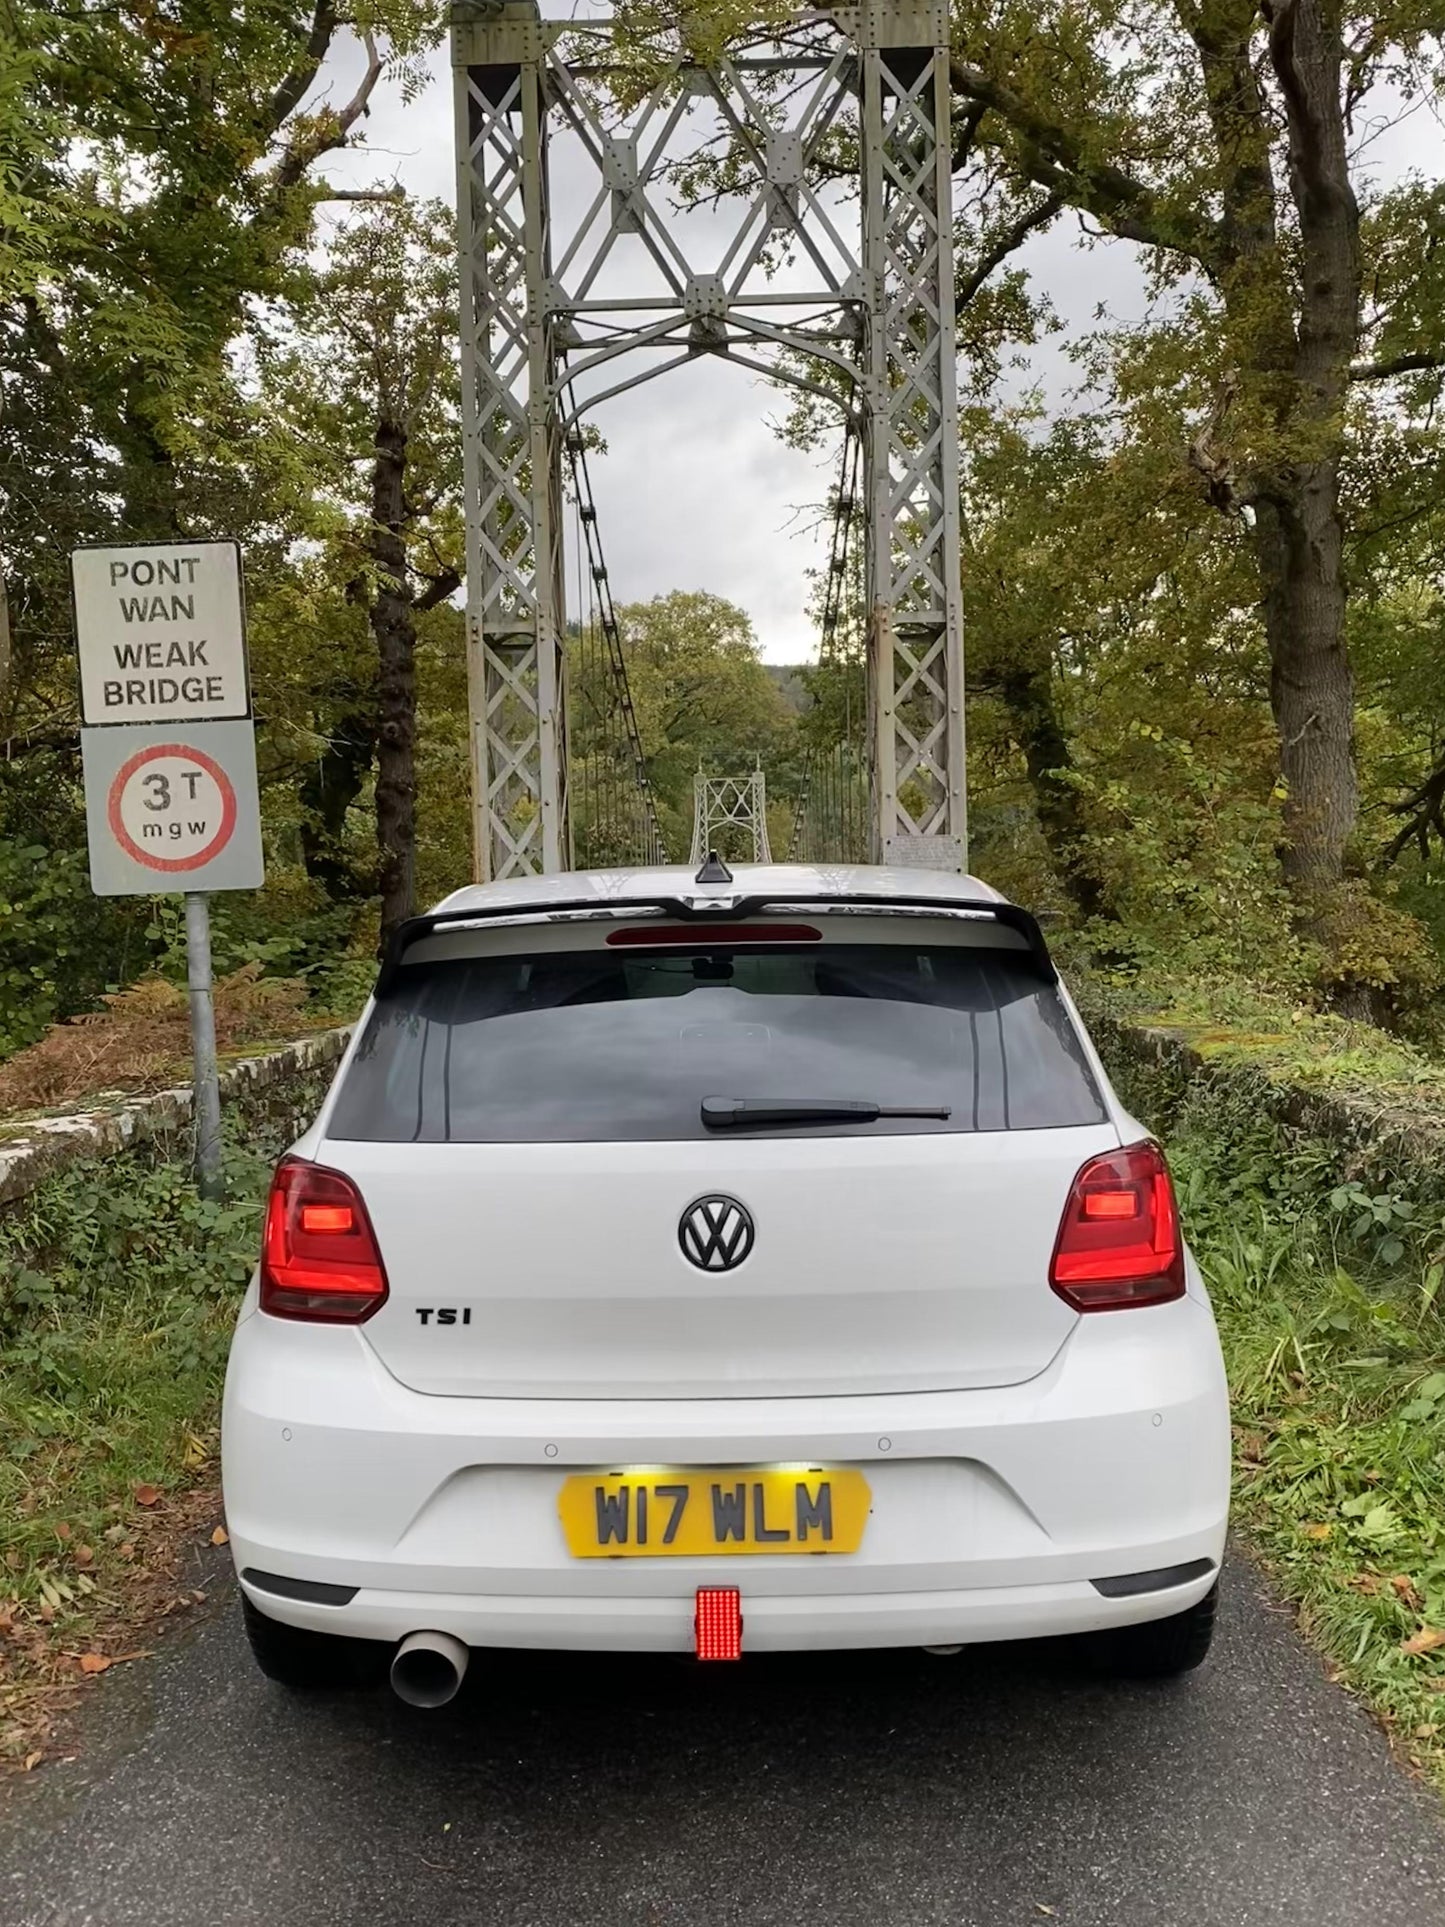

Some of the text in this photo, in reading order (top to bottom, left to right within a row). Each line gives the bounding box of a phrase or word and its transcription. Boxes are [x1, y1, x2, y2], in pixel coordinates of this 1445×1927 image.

[109, 558, 201, 587] PONT
[119, 595, 195, 623] WAN
[113, 640, 210, 670] WEAK
[103, 676, 225, 707] BRIDGE
[416, 1308, 471, 1325] TSI
[711, 1482, 833, 1542] WLM
